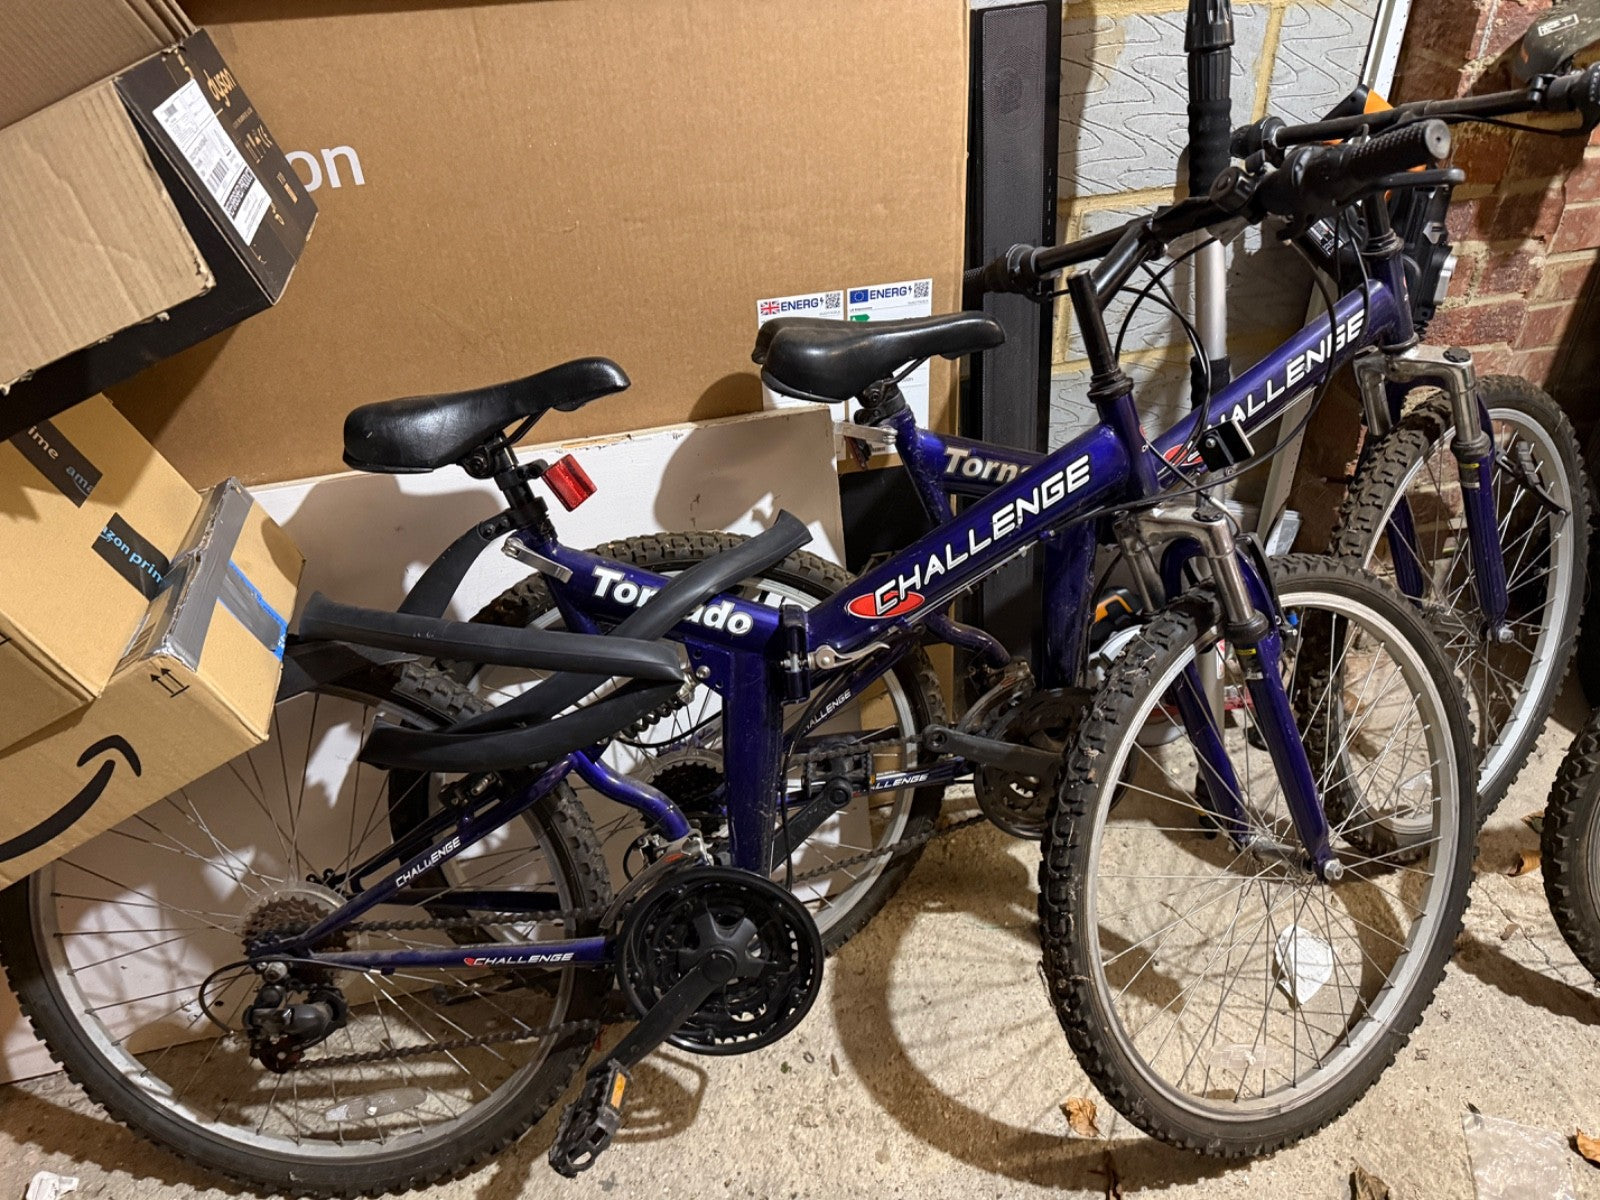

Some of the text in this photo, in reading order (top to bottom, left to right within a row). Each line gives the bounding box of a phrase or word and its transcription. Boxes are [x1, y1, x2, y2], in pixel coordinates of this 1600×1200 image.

[203, 68, 237, 108] dyson
[285, 145, 365, 192] on
[780, 298, 819, 312] ENERG
[869, 286, 908, 300] ENERG
[1187, 309, 1365, 462] ALLENGE
[27, 426, 59, 460] ime
[943, 446, 1031, 484] Torn
[873, 454, 1091, 616] CHALLENGE
[592, 565, 753, 635] Tordo
[803, 688, 852, 734] ALLENGE
[870, 773, 929, 790] LLENGE
[395, 836, 462, 888] CHALLENGE
[473, 952, 575, 966] CHALLENGE
